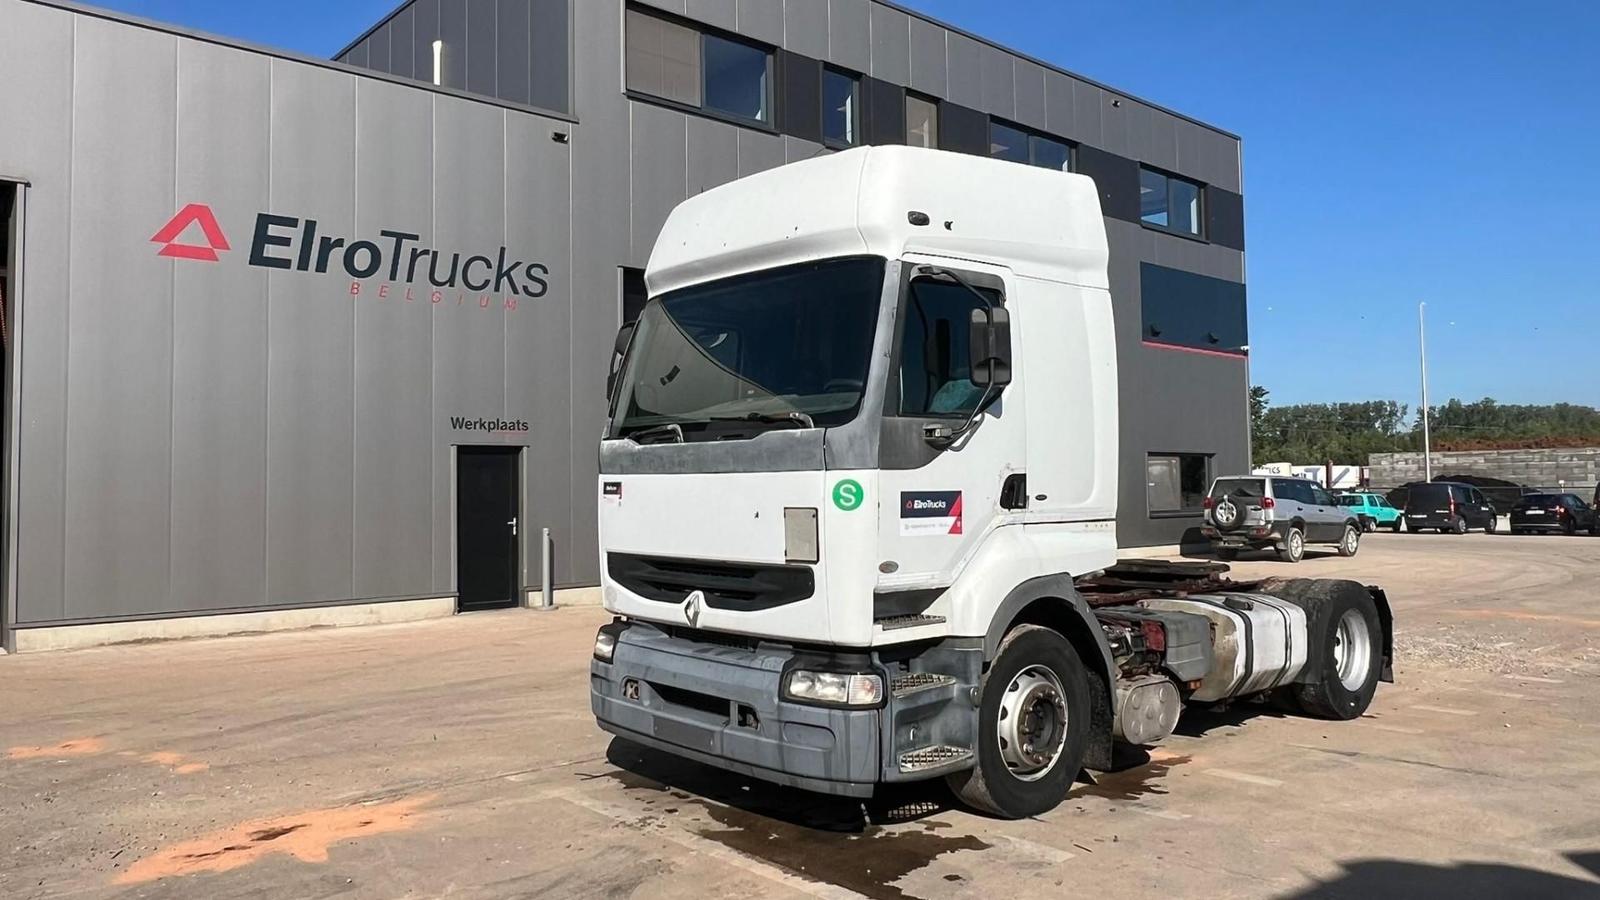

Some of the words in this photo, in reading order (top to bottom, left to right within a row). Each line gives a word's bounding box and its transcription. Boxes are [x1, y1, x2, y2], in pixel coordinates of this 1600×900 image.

[248, 212, 549, 298] ElroTrucks
[350, 281, 519, 311] BELGIUM
[450, 416, 529, 433] Werkplaats
[839, 483, 857, 507] S
